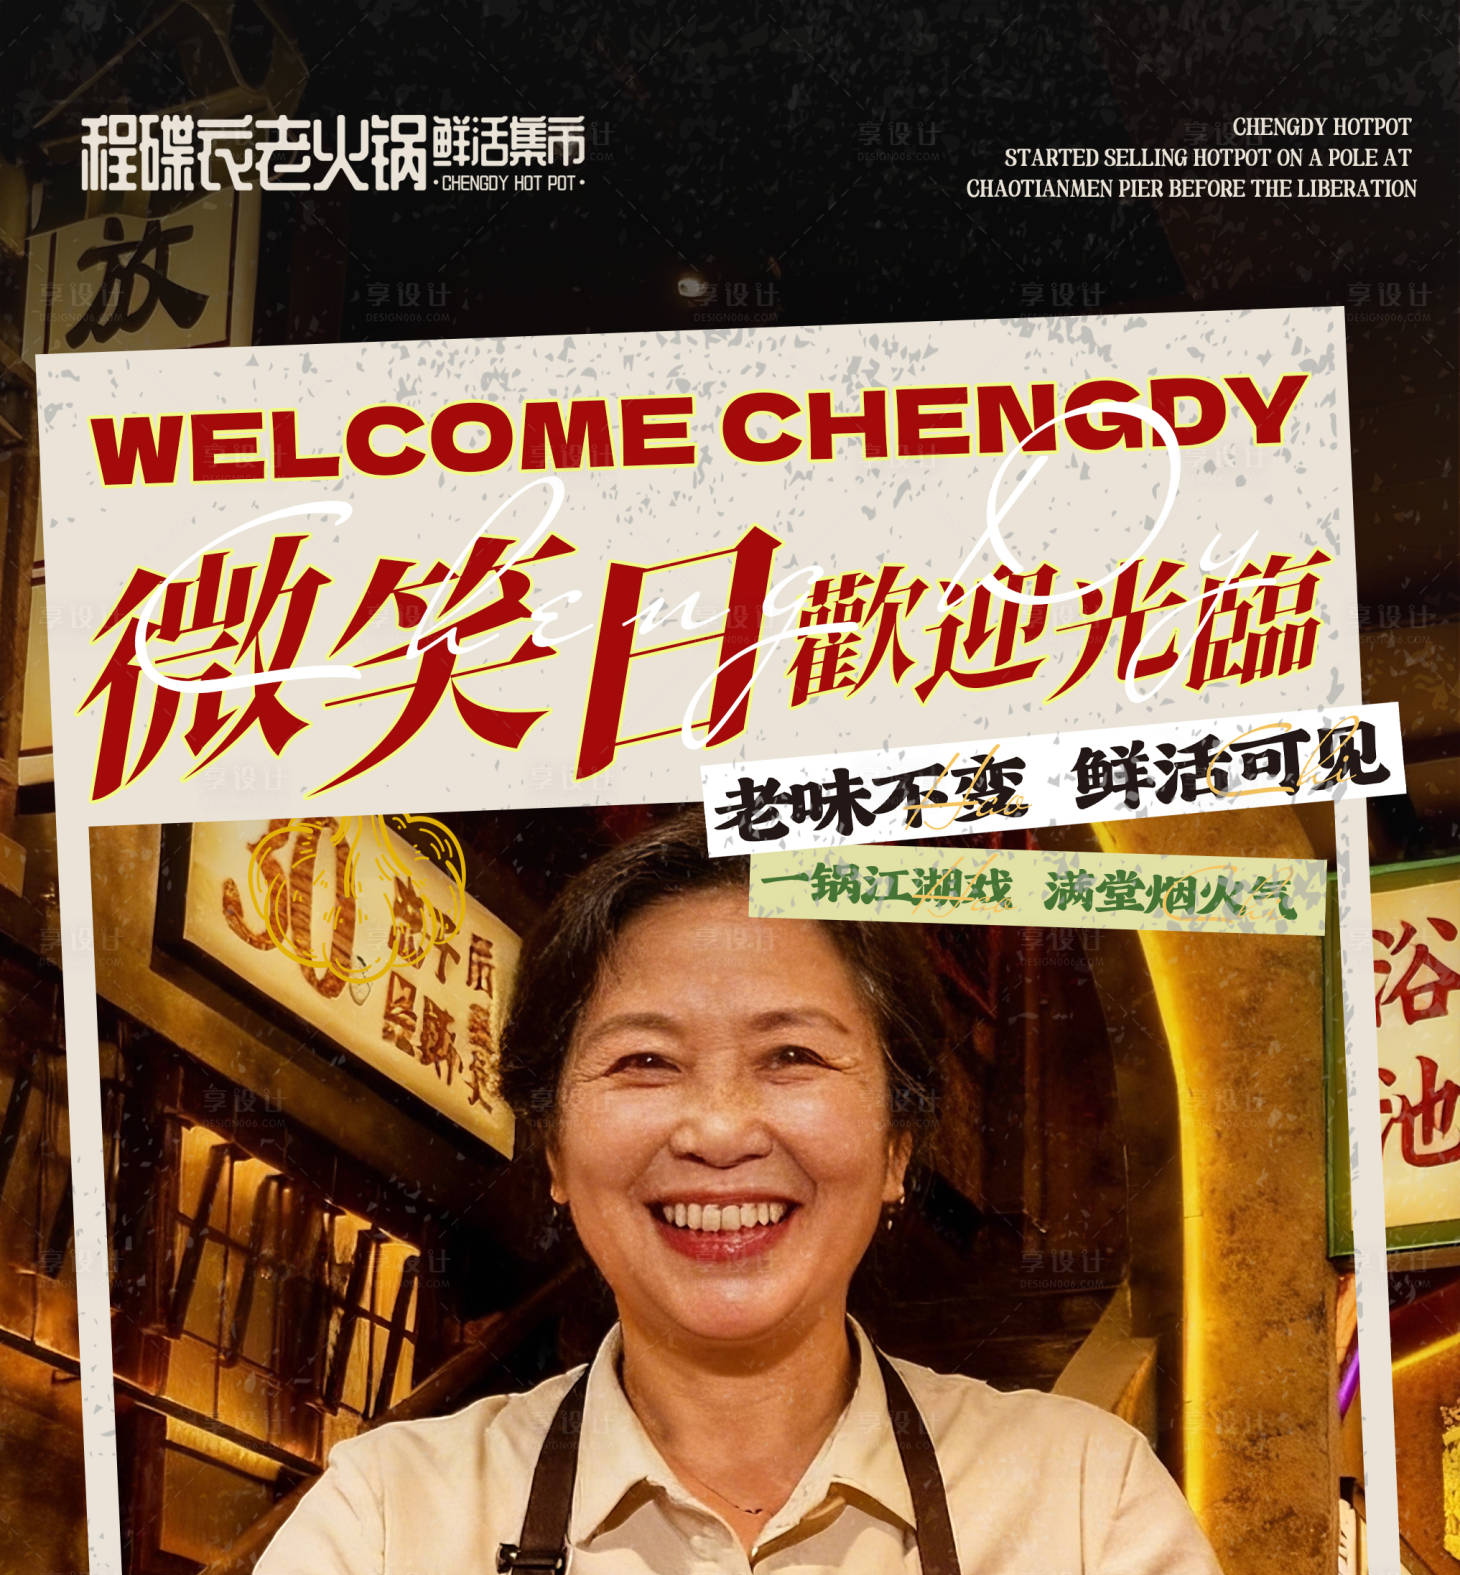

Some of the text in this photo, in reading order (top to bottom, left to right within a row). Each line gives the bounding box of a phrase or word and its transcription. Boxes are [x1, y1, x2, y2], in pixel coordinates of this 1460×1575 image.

[81, 114, 586, 192] 程碟衣老火锅 鲜活集市
[1004, 148, 1412, 167] STARTED SELLING HOTPOT ON A POLE AT
[1232, 116, 1412, 137] CHENGDY HOTPOT
[442, 174, 576, 191] CHENGDY HOT POT
[966, 178, 1418, 198] CHAOTIANMEN PIER BEFORE THE LIBERATION
[66, 216, 211, 349] 放
[89, 373, 1310, 486] WELCOME CHENGDY
[76, 524, 1334, 802] 微笑日 歡迎光臨
[714, 721, 1392, 843] 老味不变 鲜活可见
[760, 862, 1298, 921] 一锅江湖戏 满堂烟火气
